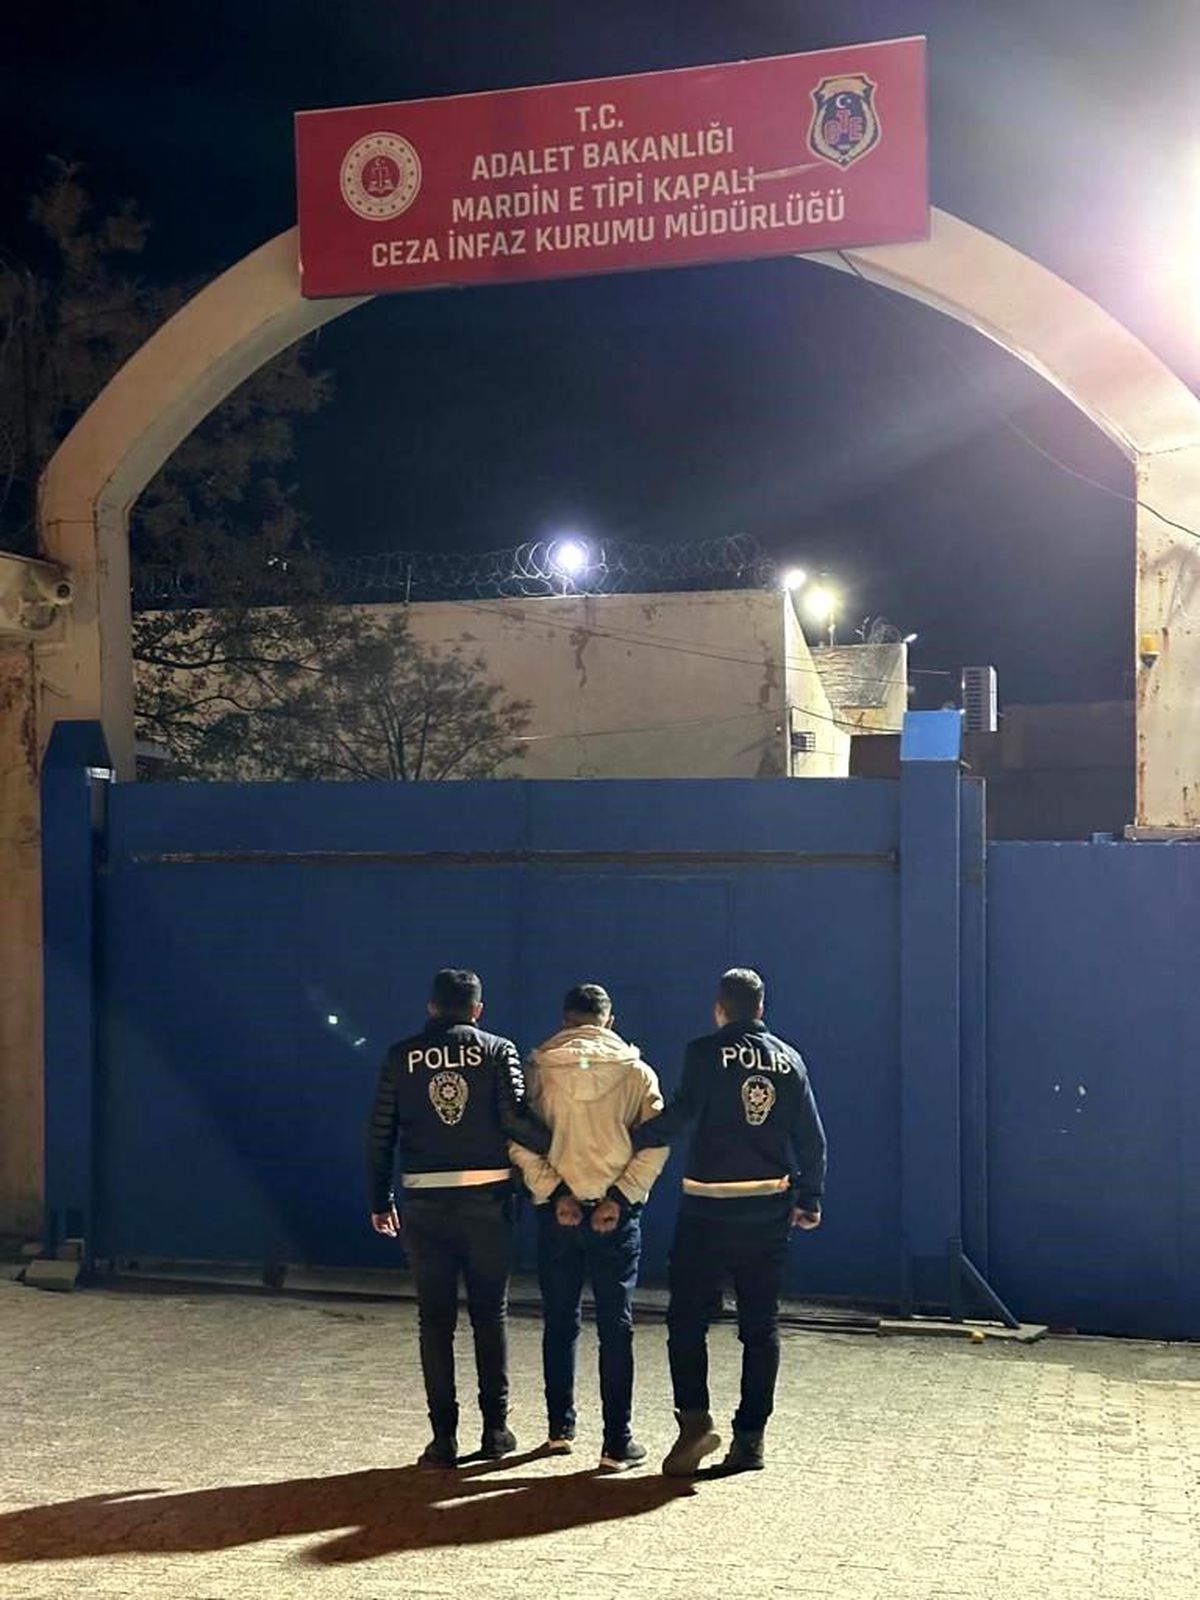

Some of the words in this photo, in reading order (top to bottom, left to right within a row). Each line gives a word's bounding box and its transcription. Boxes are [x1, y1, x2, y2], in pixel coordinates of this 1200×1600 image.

[575, 103, 624, 132] T.C.
[472, 145, 575, 181] ADALET
[583, 121, 734, 169] BAKANLIĞI
[452, 184, 559, 223] MARDİN
[569, 186, 584, 211] E
[592, 172, 644, 208] TİPİ
[653, 165, 755, 203] KAPALI
[372, 238, 440, 268] CEZA
[449, 230, 526, 261] İNFAZ
[536, 216, 655, 252] KURUMU
[664, 187, 845, 239] MÜDÜRLÜĞÜ
